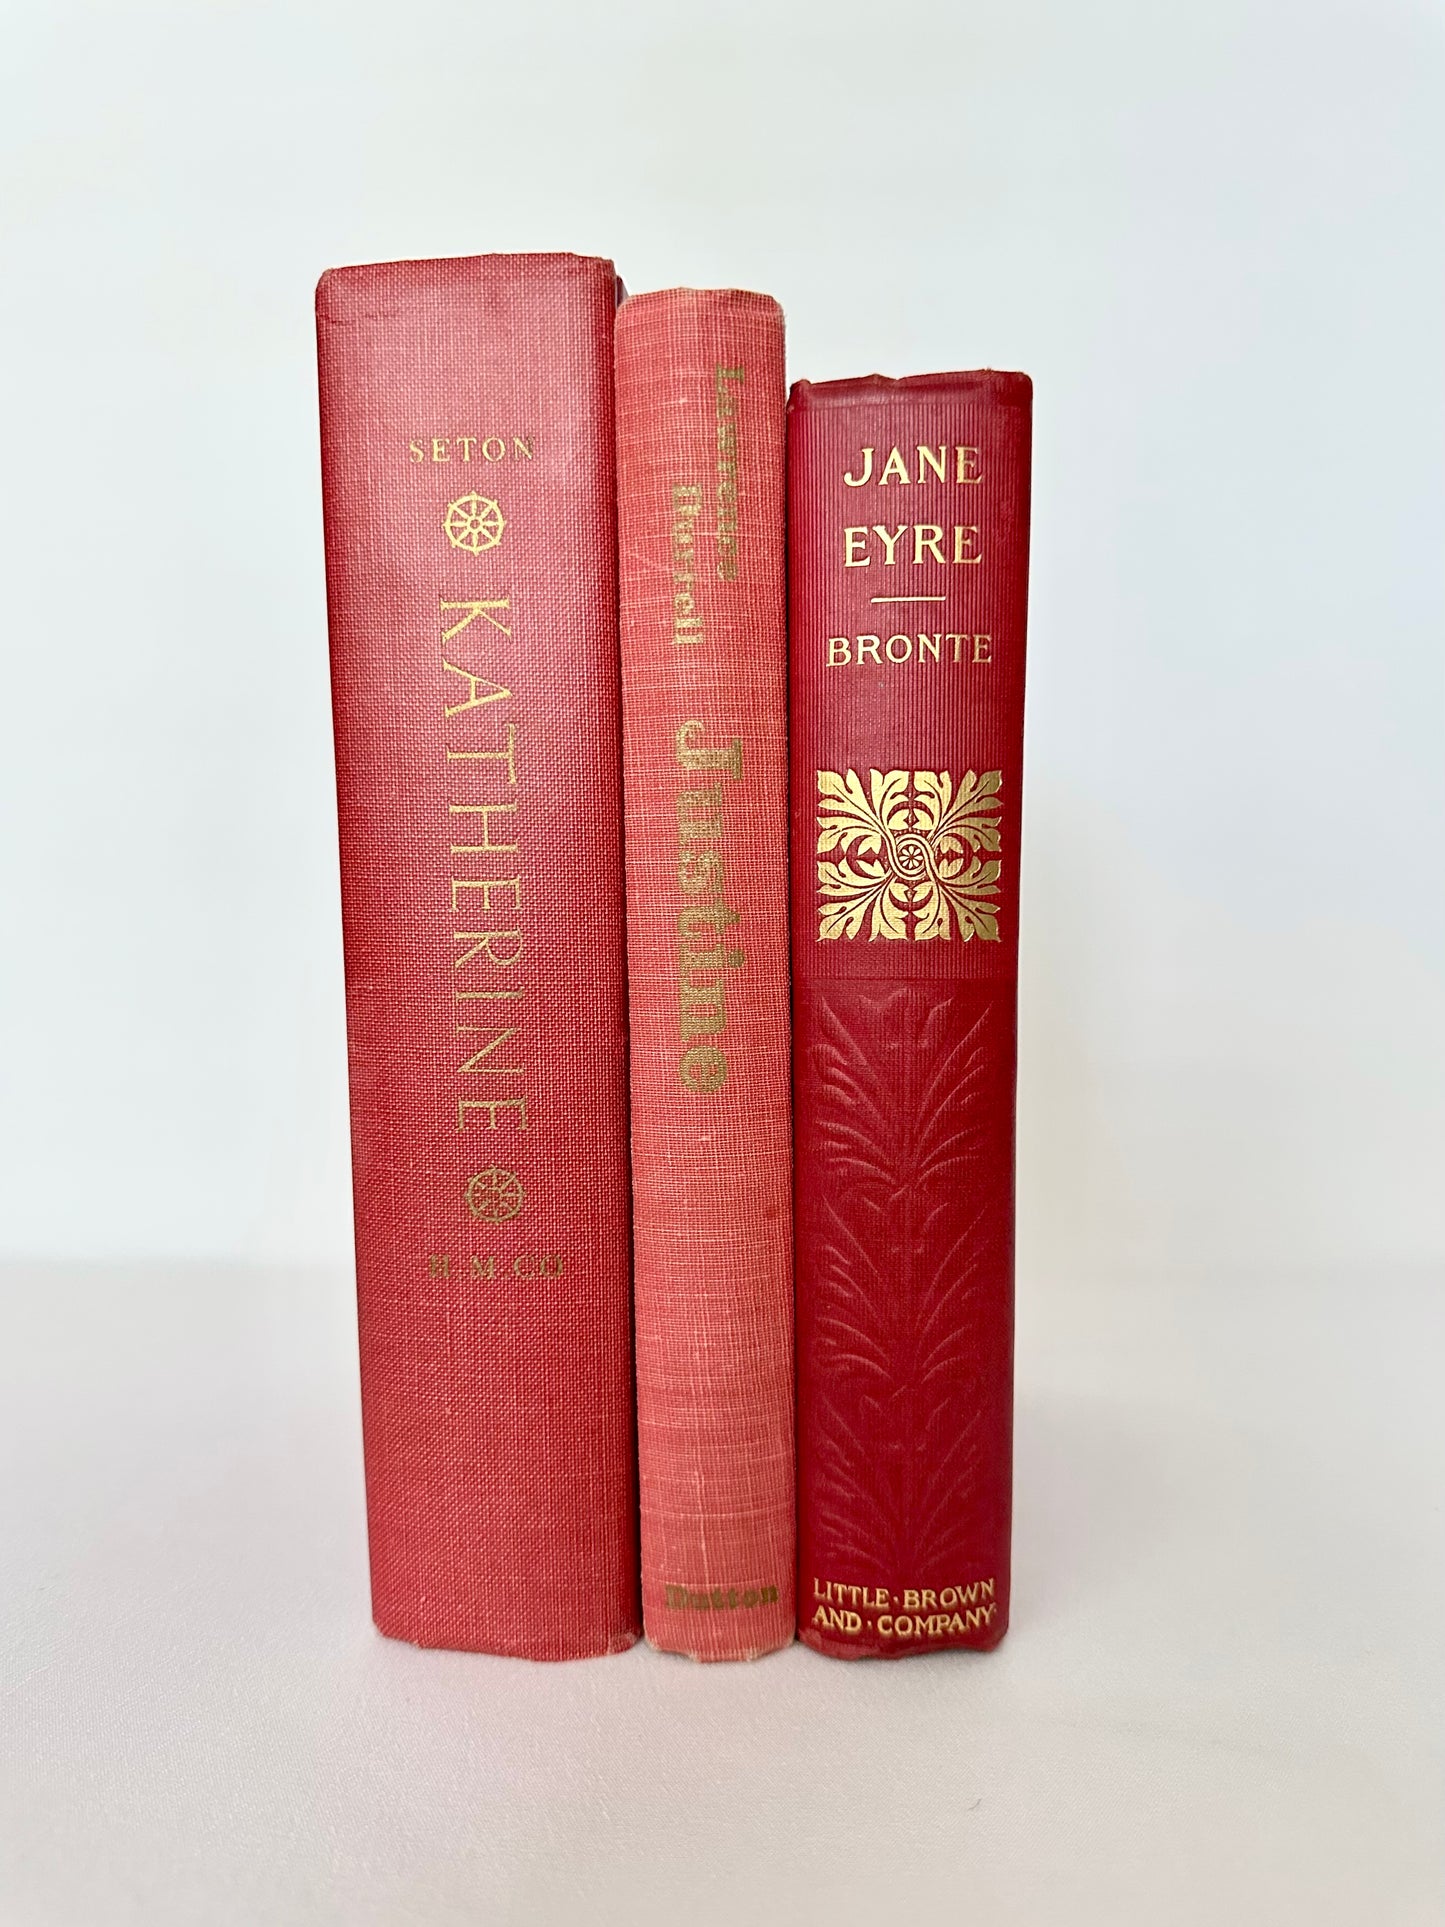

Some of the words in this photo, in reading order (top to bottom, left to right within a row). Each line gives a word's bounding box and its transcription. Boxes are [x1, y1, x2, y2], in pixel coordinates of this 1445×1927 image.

[409, 436, 535, 463] SETON
[843, 445, 983, 486] JANE
[716, 364, 745, 581] Lawrence
[673, 484, 704, 644] Durrell
[843, 524, 983, 567] EYRE
[825, 633, 993, 667] BRONTE
[438, 595, 528, 1133] KATHERINE
[676, 720, 744, 1093] Justine
[665, 1585, 778, 1610] Dutton
